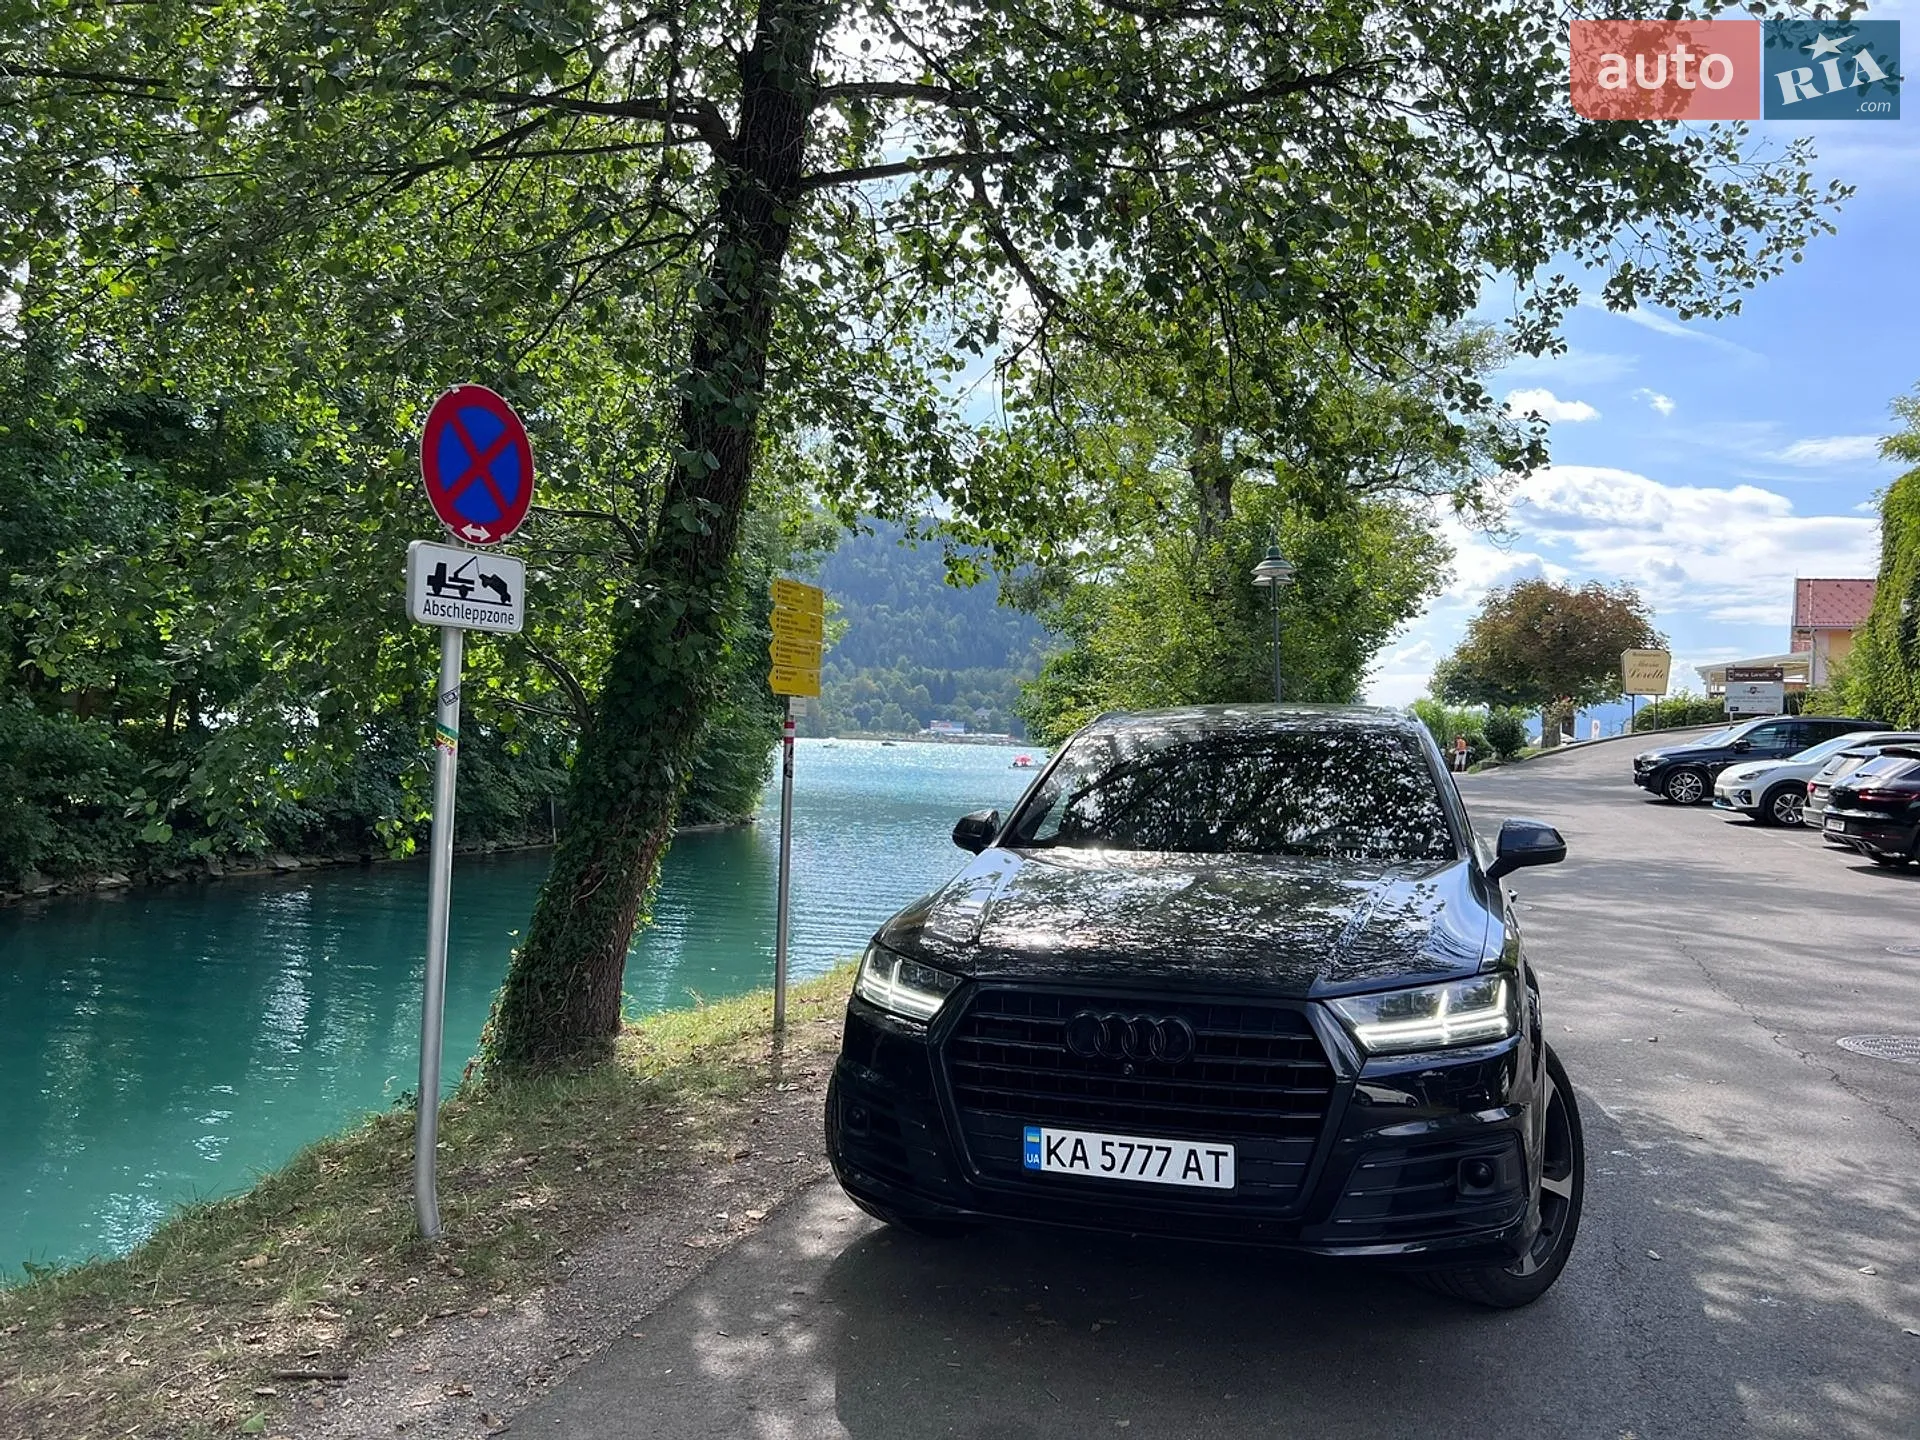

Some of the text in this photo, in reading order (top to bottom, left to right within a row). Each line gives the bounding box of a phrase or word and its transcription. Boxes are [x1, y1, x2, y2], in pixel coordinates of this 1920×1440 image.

[422, 598, 515, 625] Abschleppzone
[1026, 1153, 1040, 1164] UA
[1046, 1135, 1229, 1183] KA 5777 AT
